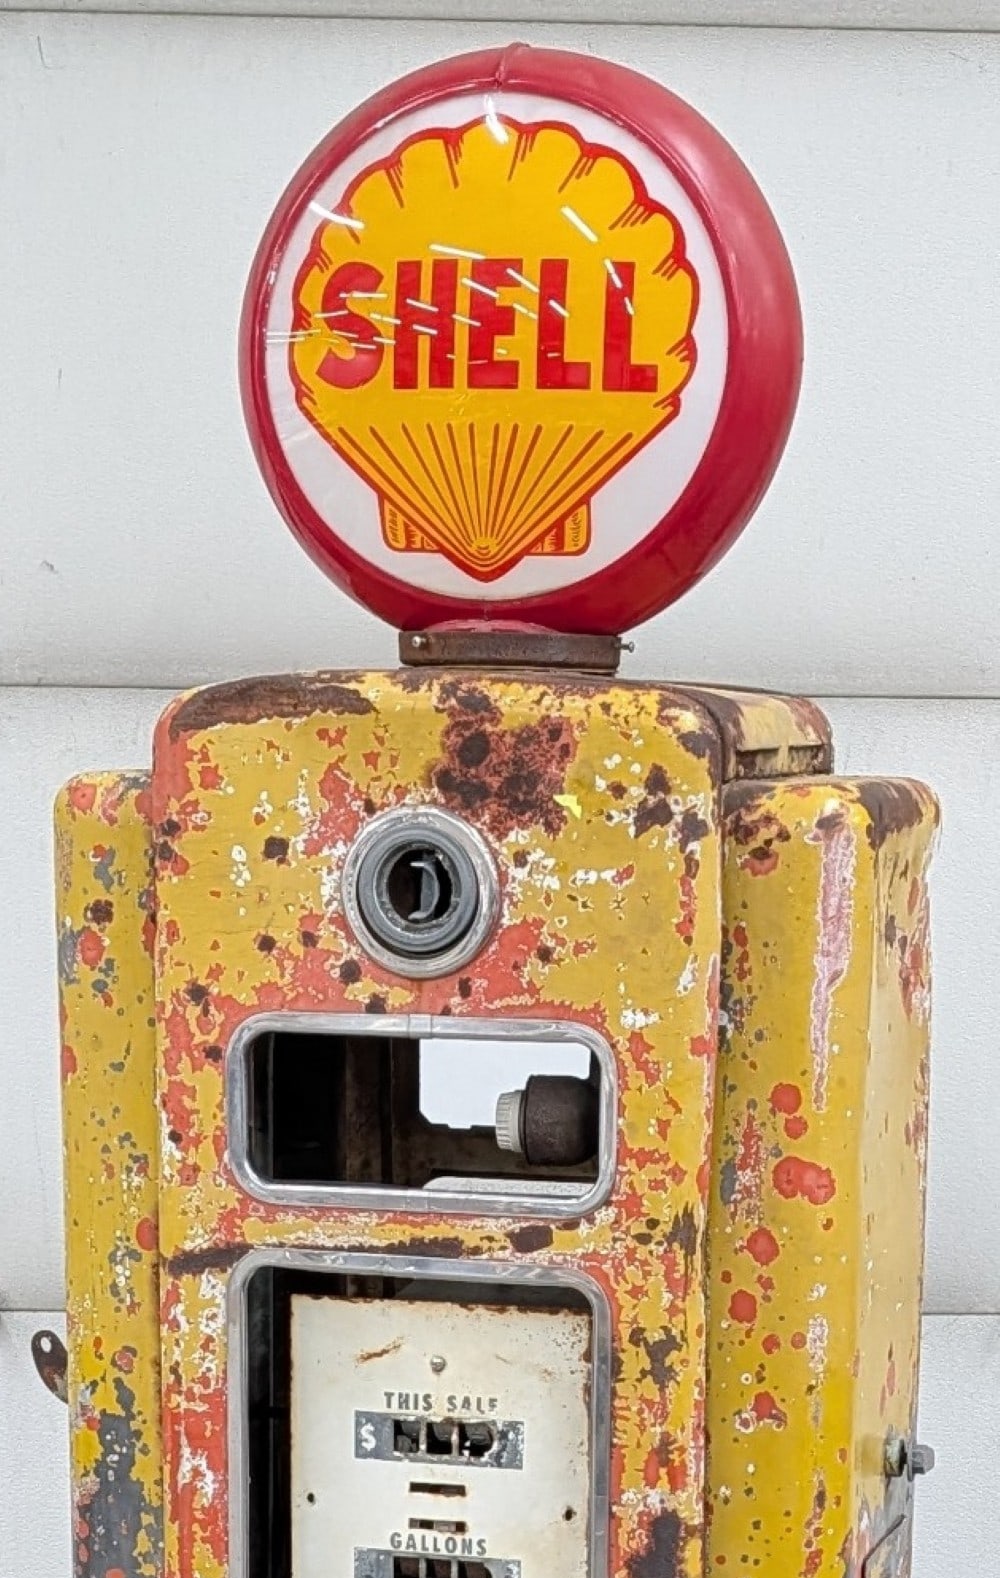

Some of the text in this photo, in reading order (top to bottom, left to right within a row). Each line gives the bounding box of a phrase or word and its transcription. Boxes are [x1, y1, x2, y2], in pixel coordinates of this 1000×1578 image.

[315, 258, 659, 393] SHELL
[384, 1391, 498, 1415] THIS SALE
[390, 1531, 487, 1556] GALLONS
